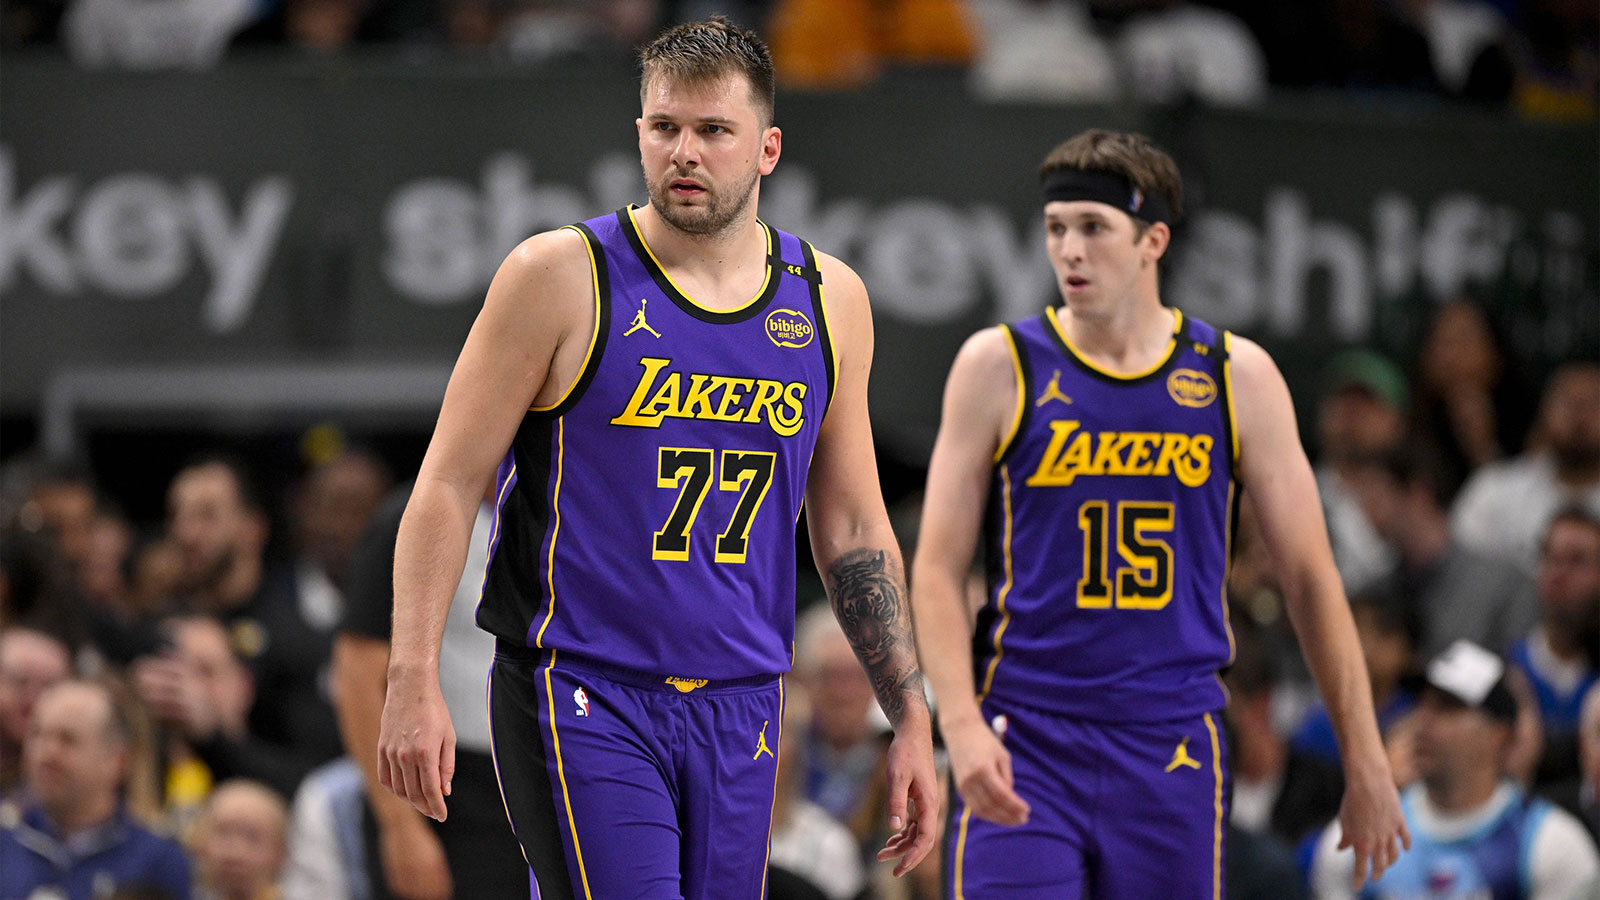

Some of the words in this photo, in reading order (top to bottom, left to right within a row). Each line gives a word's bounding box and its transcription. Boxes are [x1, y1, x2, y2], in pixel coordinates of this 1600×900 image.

[787, 264, 802, 276] 44
[769, 318, 811, 338] bibigo
[609, 356, 809, 437] LAKERS
[1025, 419, 1214, 488] LAKERS
[652, 446, 777, 564] 77
[1076, 500, 1175, 610] 15
